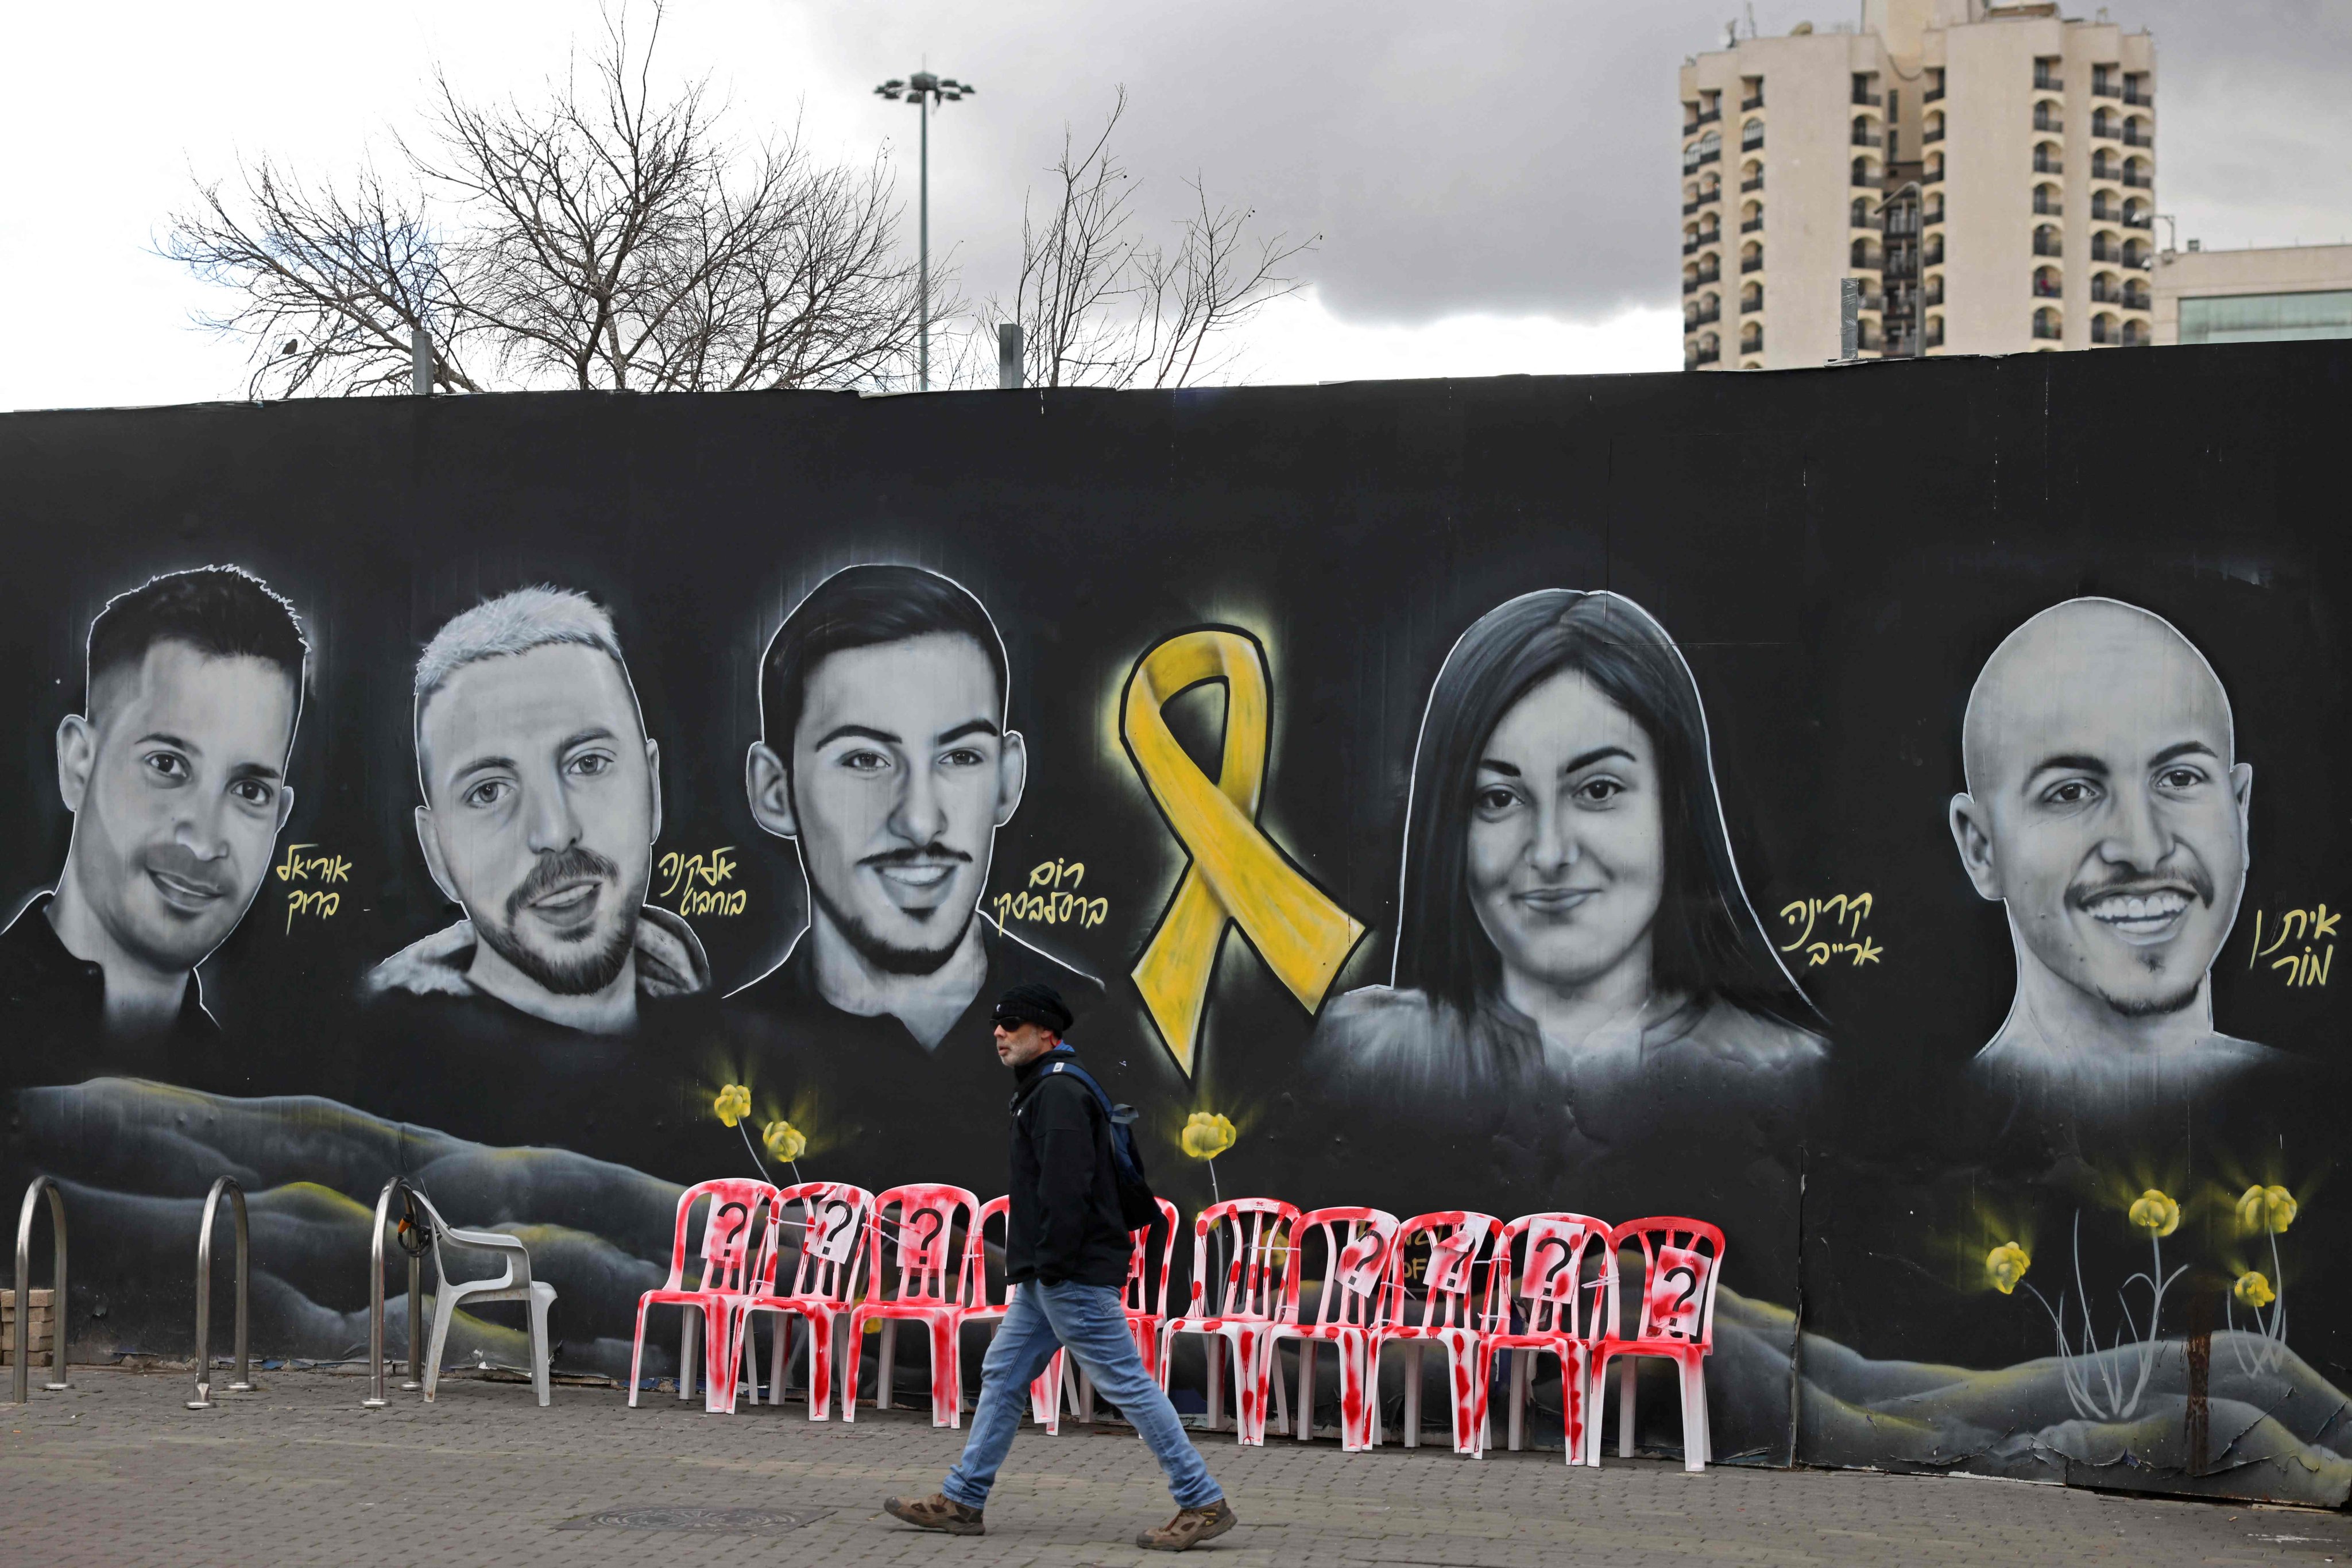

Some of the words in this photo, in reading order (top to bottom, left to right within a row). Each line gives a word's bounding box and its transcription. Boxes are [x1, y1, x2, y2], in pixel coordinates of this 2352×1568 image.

[659, 846, 736, 897] אלקנה
[286, 890, 340, 936] ברוך
[680, 887, 746, 916] בוחבוט
[993, 891, 1108, 938] ברסלבסקי
[1780, 892, 1873, 952] קרינה
[1805, 936, 1884, 967] ארייב
[2249, 903, 2342, 970] איתן
